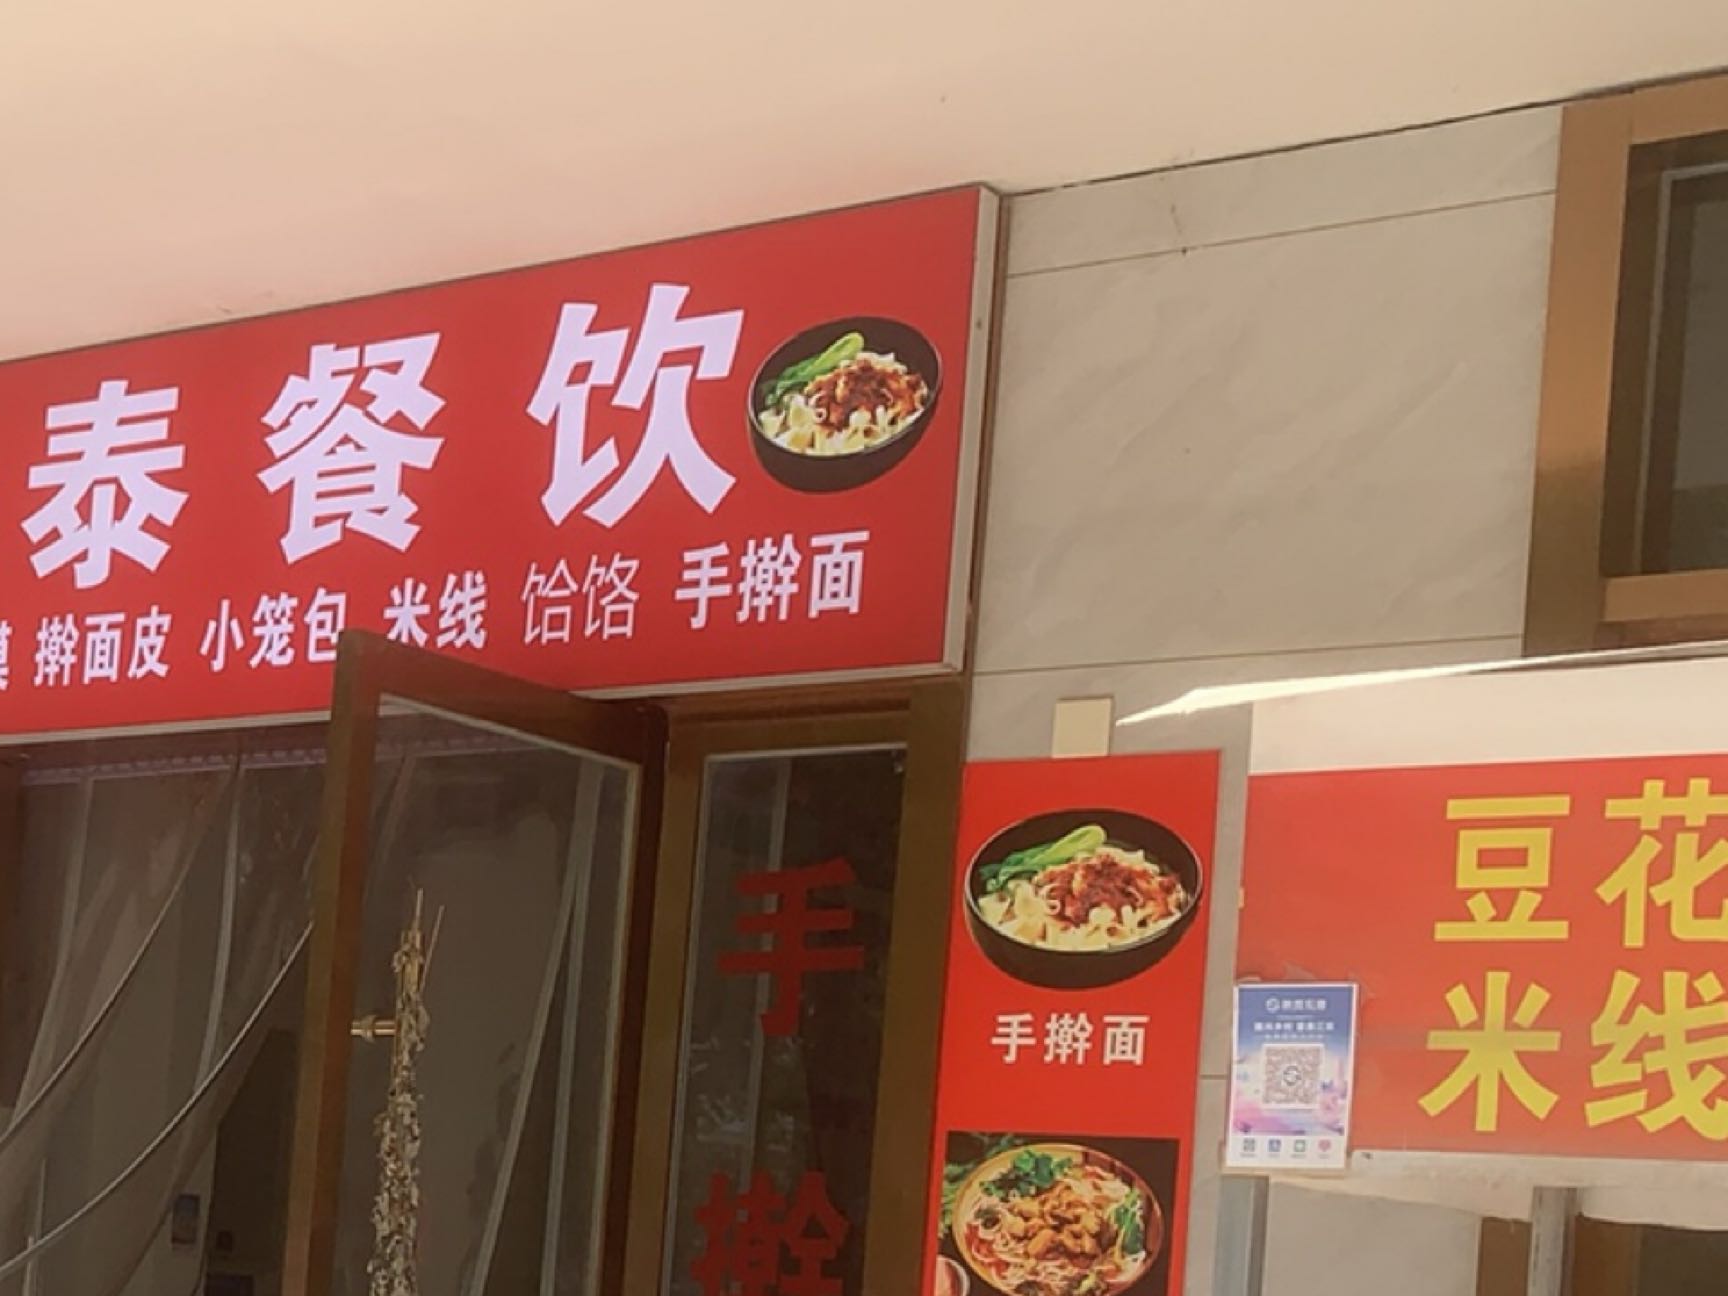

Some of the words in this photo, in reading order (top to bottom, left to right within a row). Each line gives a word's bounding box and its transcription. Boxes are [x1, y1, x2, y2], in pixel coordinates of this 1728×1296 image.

[34, 605, 172, 687] 擀面皮
[200, 587, 346, 672] 小笼包
[383, 570, 486, 649] 米线
[521, 552, 640, 645] 饸饹
[675, 530, 870, 630] 手擀面
[1433, 778, 1728, 948] 豆花
[991, 1013, 1149, 1065] 手擀面
[1417, 970, 1728, 1140] 米线
